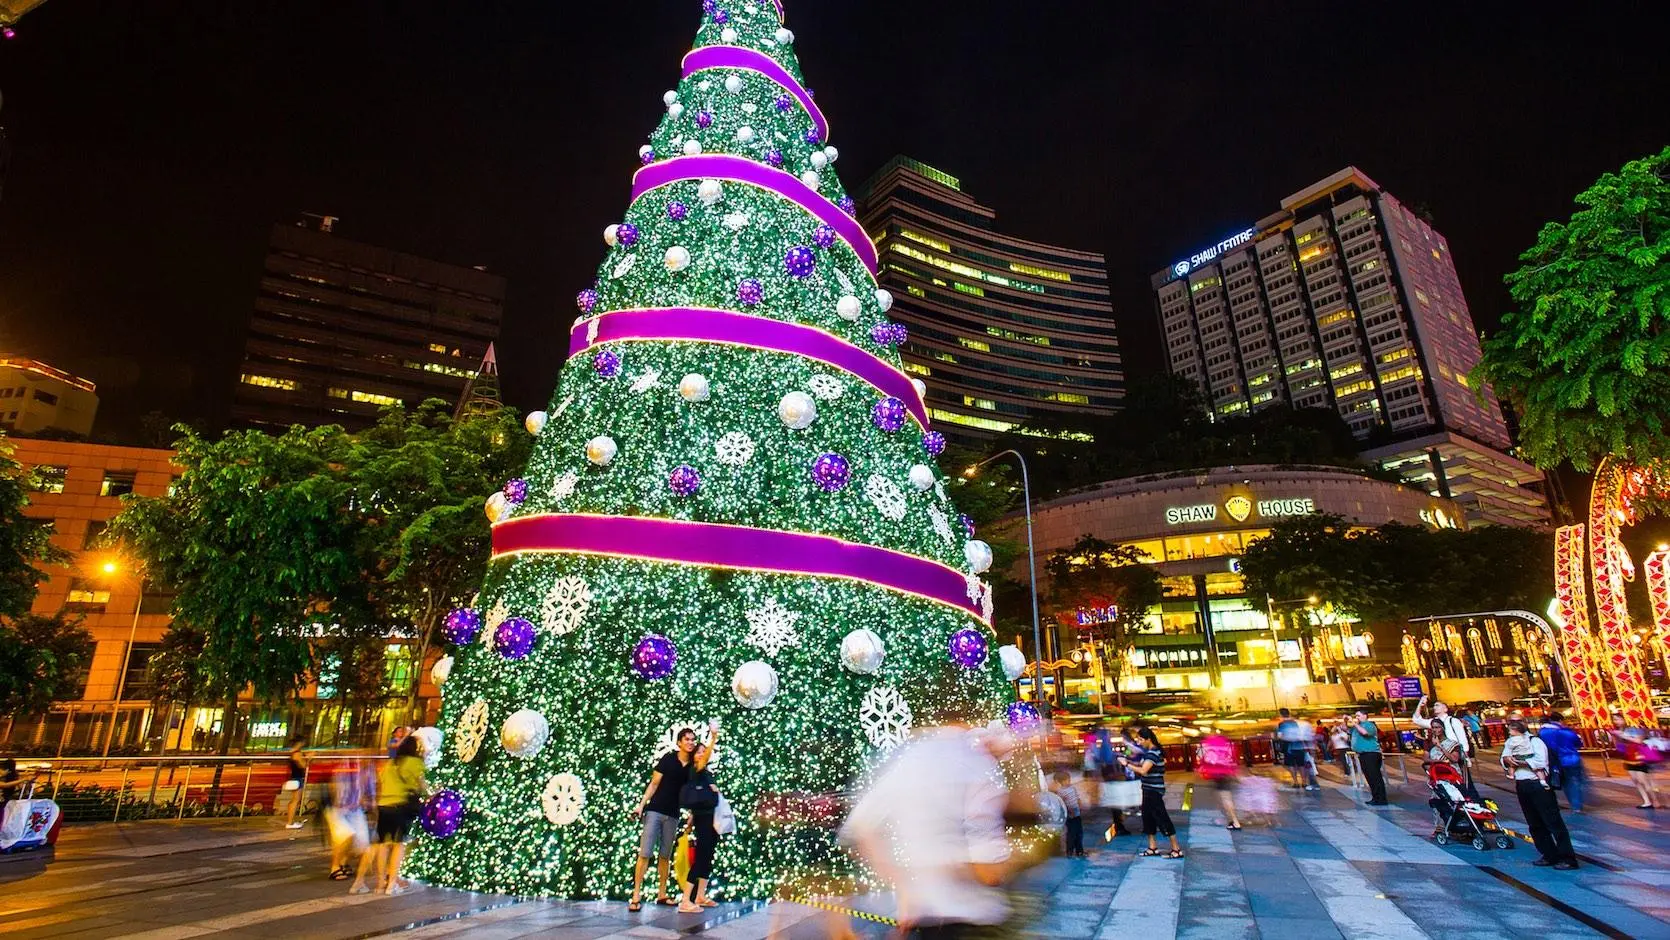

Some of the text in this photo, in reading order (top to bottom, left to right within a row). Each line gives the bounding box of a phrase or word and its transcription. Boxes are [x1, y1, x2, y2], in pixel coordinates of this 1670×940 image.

[1190, 228, 1253, 268] SHAW CENTRE
[1167, 499, 1315, 524] SHAW HOUSE
